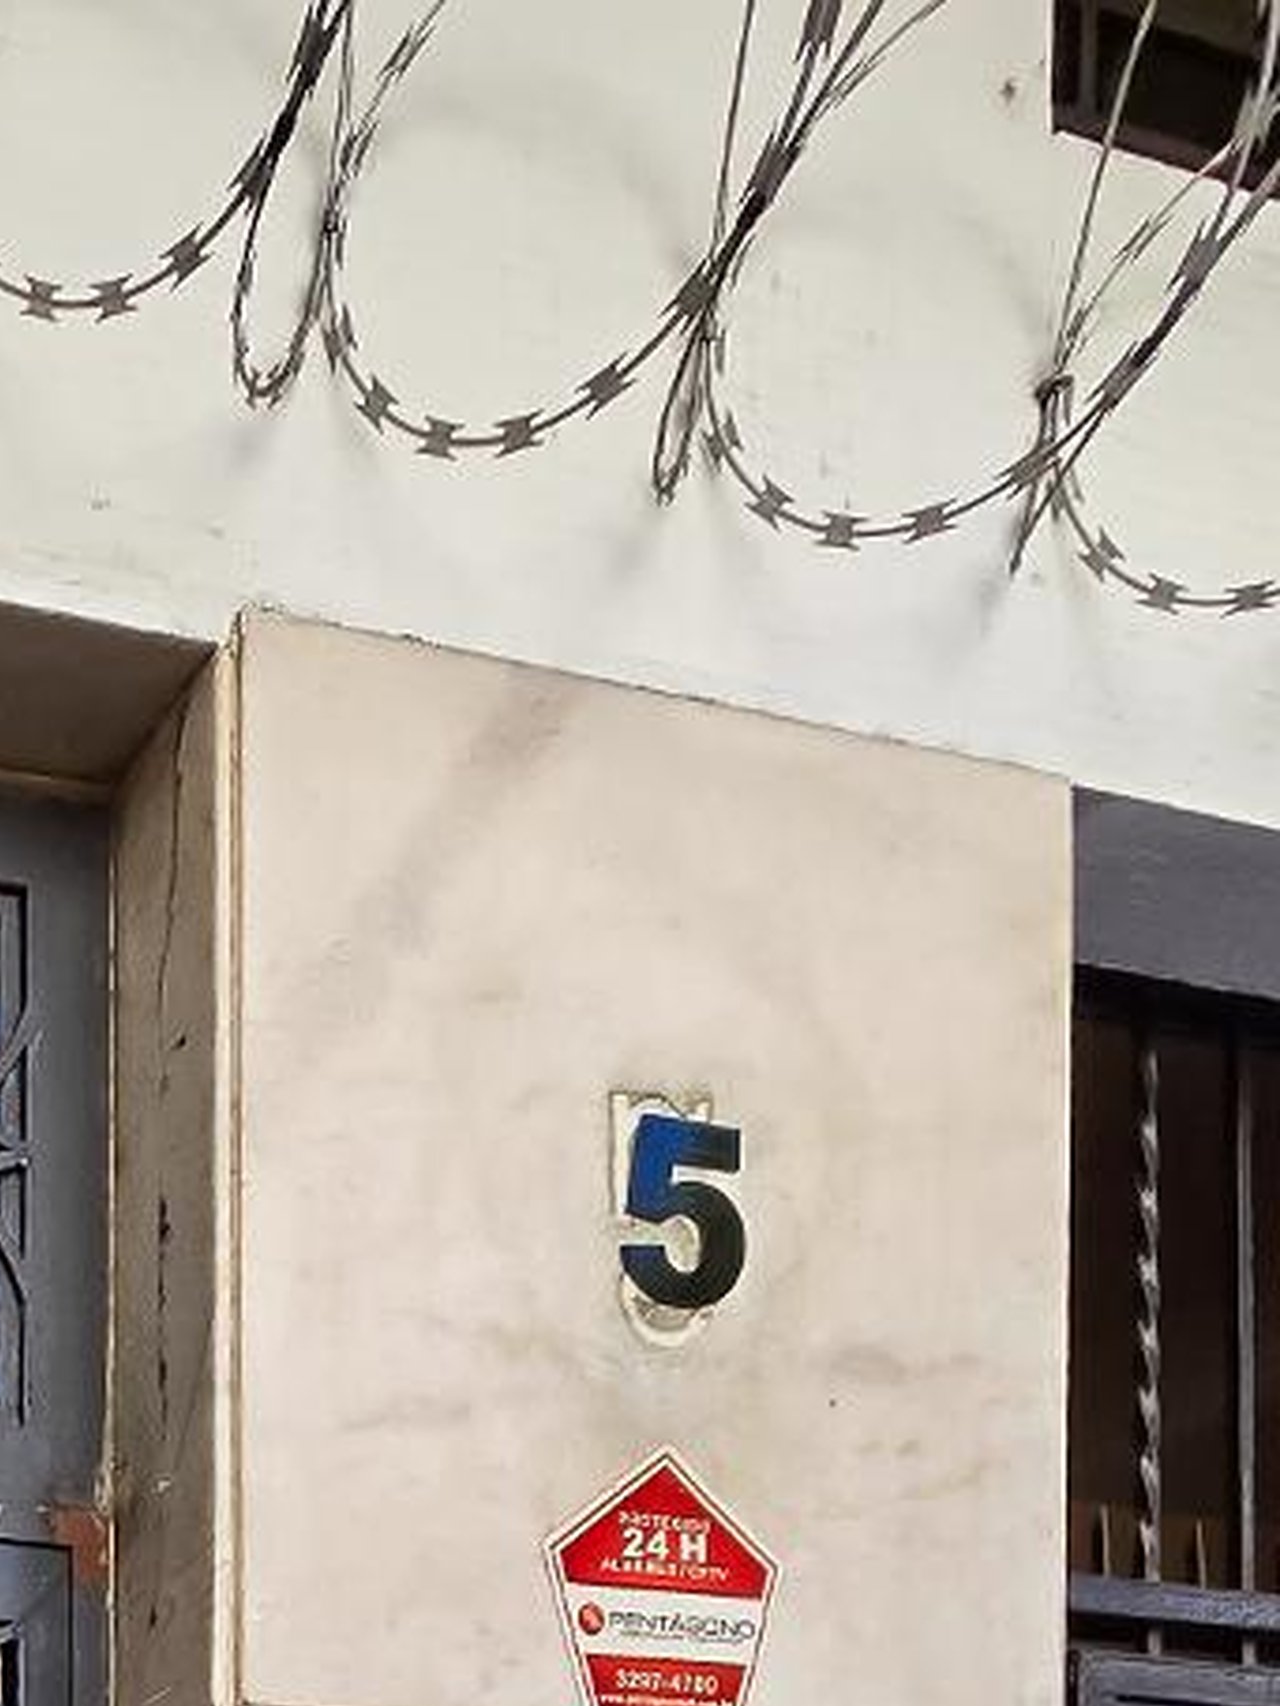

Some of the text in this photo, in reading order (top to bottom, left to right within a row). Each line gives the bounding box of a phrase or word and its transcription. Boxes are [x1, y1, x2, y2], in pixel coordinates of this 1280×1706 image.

[620, 1113, 746, 1308] 5
[622, 1527, 707, 1564] 24 H
